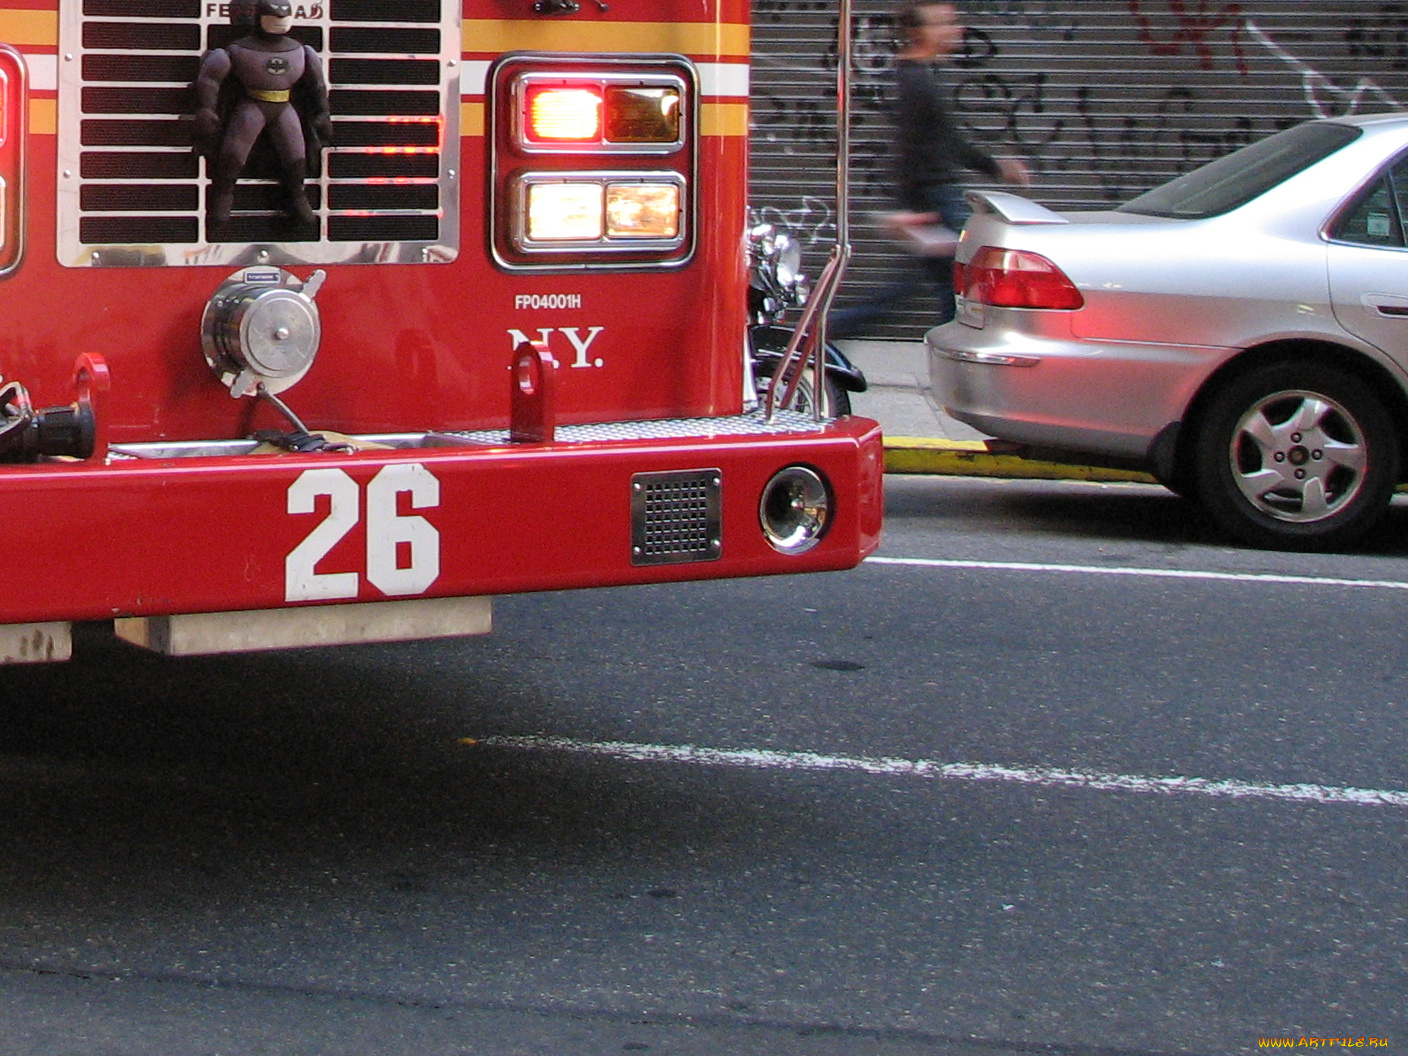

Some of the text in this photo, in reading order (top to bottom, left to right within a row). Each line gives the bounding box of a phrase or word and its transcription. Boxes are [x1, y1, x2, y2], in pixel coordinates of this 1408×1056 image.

[514, 293, 582, 310] FP04001H
[506, 326, 605, 370] N.Y.
[284, 462, 441, 603] 26
